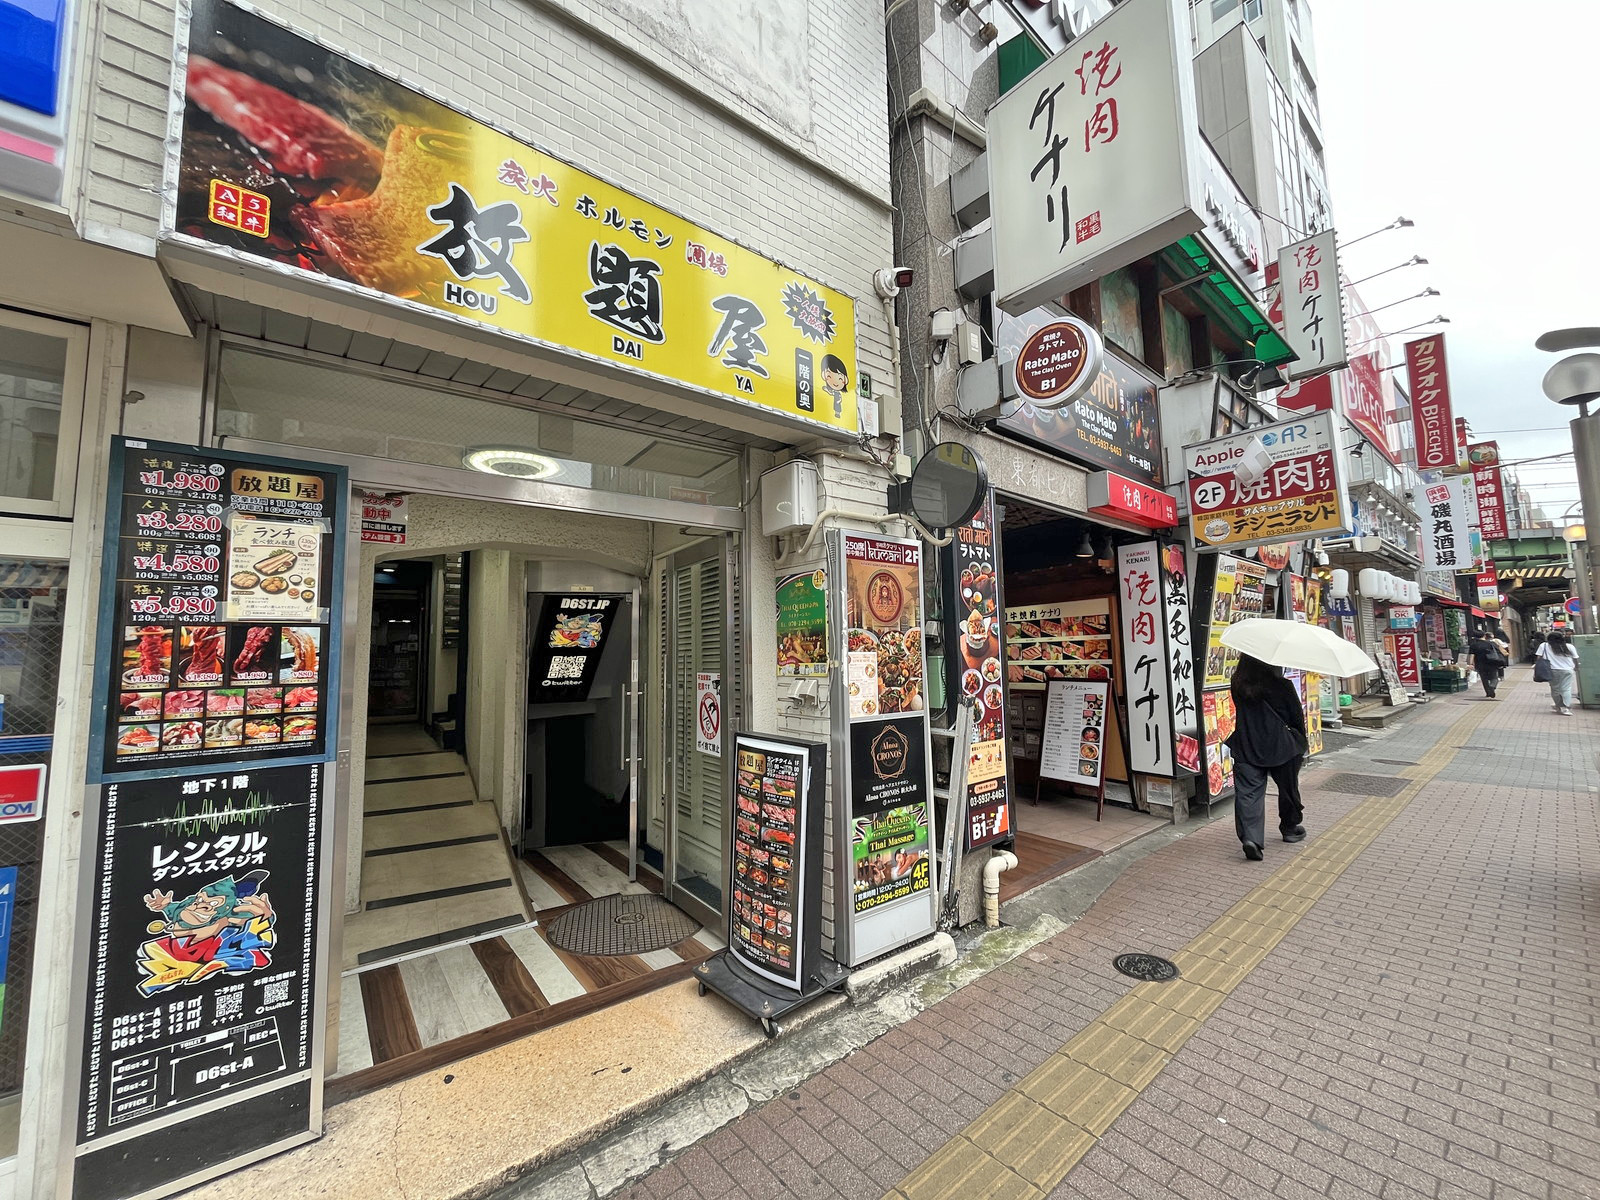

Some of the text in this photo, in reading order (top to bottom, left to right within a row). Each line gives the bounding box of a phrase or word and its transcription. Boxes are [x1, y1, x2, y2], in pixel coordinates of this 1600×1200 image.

[1074, 41, 1122, 152] 焼肉
[1029, 82, 1070, 254] ケナリ
[499, 160, 729, 276] 炭火 ホルモン 酒場
[1294, 244, 1324, 364] 焼肉 ケナリ
[446, 282, 755, 394] HOU DAI YA
[1039, 339, 1065, 352] ラトマト
[1025, 349, 1079, 370] Rato Mato
[798, 353, 811, 409] 一階の奥
[1414, 341, 1441, 404] カラオケ
[1041, 378, 1056, 390] B1
[1075, 400, 1095, 421] Rato
[1097, 409, 1117, 432] Mato
[1082, 419, 1113, 440] The Clay Oven
[1195, 447, 1245, 467] Apple
[238, 475, 318, 499] 放題屋
[1230, 454, 1330, 505] 焼肉 ケナリ
[1198, 486, 1221, 504] 2F
[1233, 504, 1337, 534] デジニランド
[254, 527, 295, 539] ランチ
[1430, 502, 1457, 566] 磯丸酒場
[905, 549, 919, 563] 2F
[960, 544, 991, 561] ラトマト
[1126, 557, 1150, 565] KENARI
[561, 598, 610, 610] D6ST.JP
[1166, 571, 1195, 725] 黒毛和牛
[1398, 636, 1415, 678] カラオケ
[767, 756, 792, 765] ランチタイム
[182, 775, 250, 795] 地下1階
[972, 821, 987, 840] B1
[152, 831, 269, 868] レンタル
[870, 833, 915, 852] Thai Massage
[152, 851, 267, 882] ダンススタジオ
[913, 862, 929, 879] 4F
[914, 877, 929, 890] 406
[862, 886, 909, 909] 070-2294-5599
[169, 1001, 184, 1013] 58
[265, 999, 295, 1011] twitter
[169, 1012, 184, 1024] 12
[168, 1023, 184, 1035] 12
[195, 1055, 254, 1084] D6st-A
[117, 1079, 148, 1094] D6st-C
[117, 1097, 147, 1111] OFFICE
